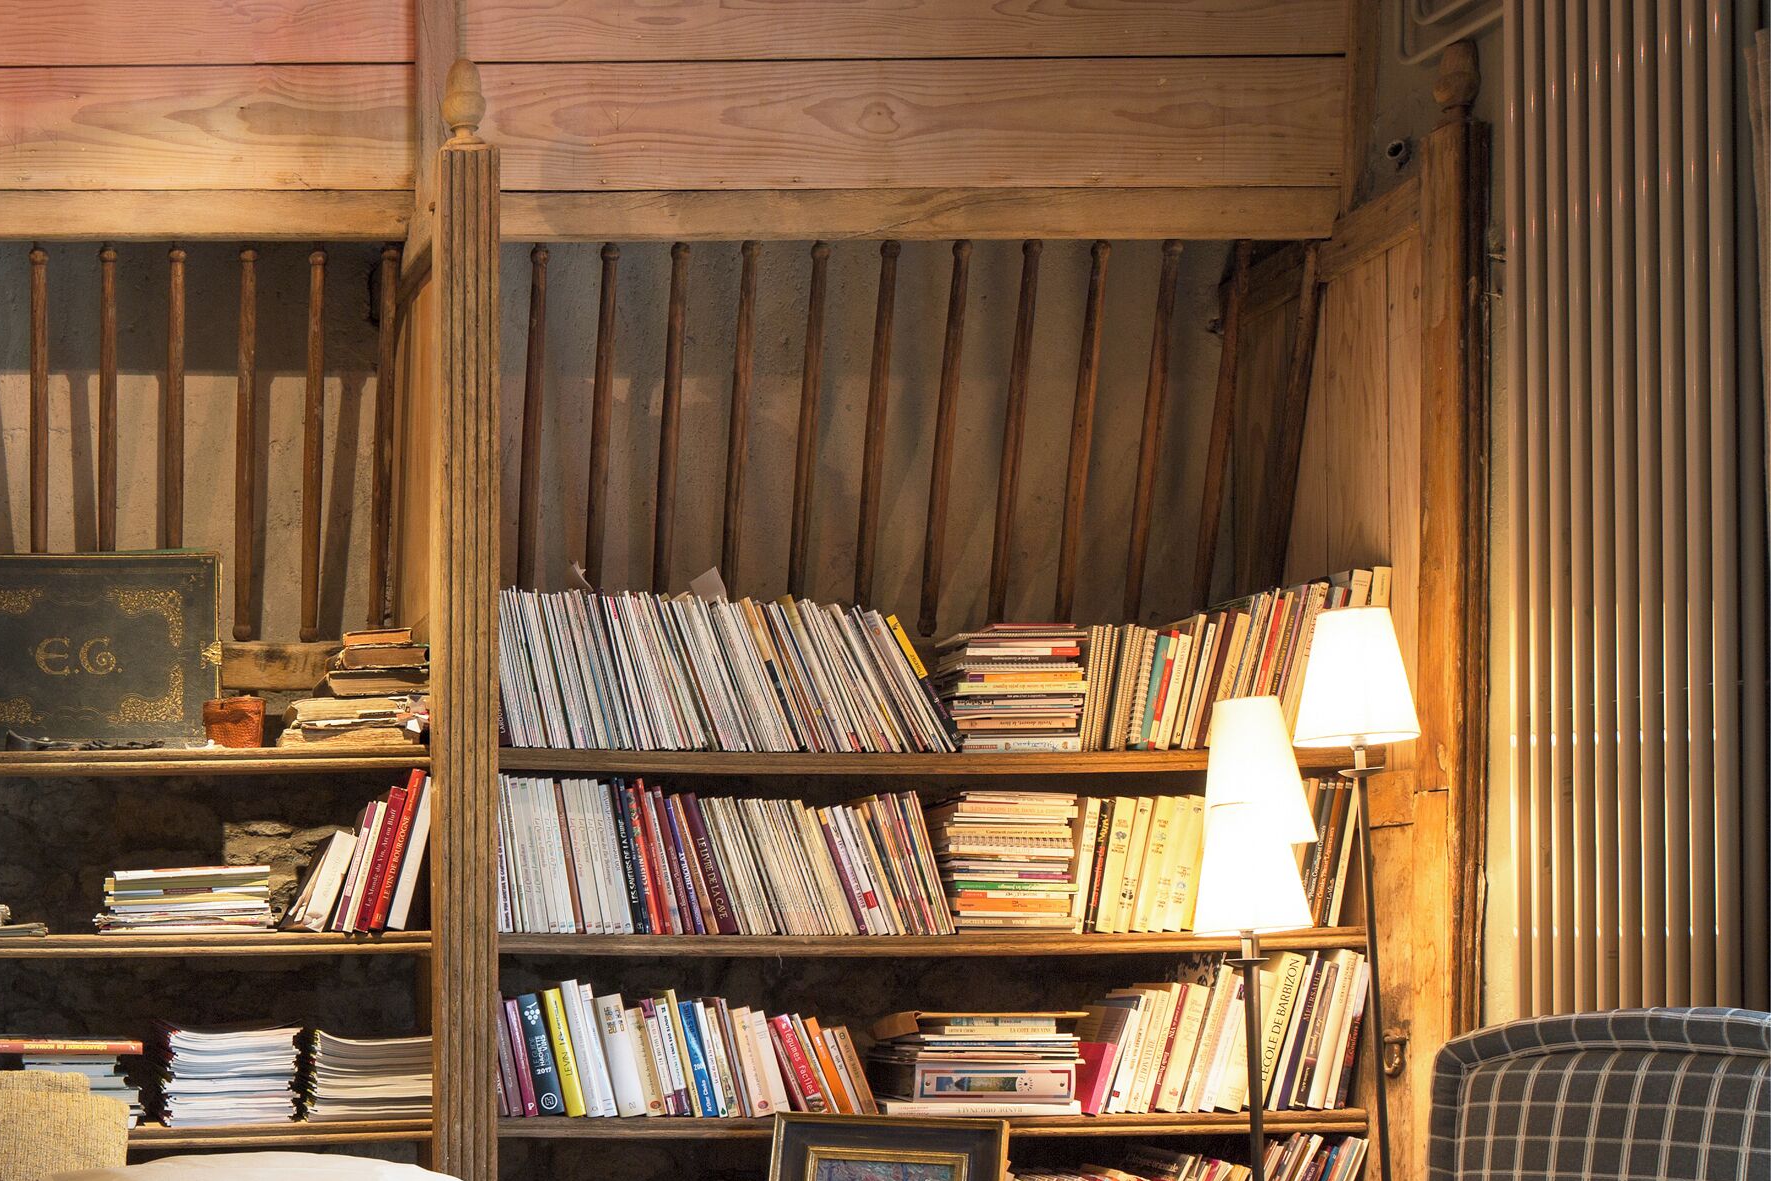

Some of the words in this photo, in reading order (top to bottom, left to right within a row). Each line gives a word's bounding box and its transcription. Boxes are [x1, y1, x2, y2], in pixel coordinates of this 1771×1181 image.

[35, 636, 124, 676] E.G.
[907, 652, 925, 677] Provence
[385, 807, 398, 826] Bluff
[382, 825, 393, 836] ou
[616, 817, 627, 838] CHINE
[379, 835, 390, 848] Art
[391, 814, 411, 863] BOURGOGNE
[620, 837, 629, 849] LA
[695, 836, 707, 849] LE
[622, 848, 631, 860] DE
[698, 847, 714, 872] LIVRE
[372, 861, 383, 873] du
[388, 862, 398, 874] DE
[624, 860, 637, 889] SAVEURS
[677, 850, 693, 890] CHOCOLAT
[366, 872, 380, 896] Monde
[384, 873, 395, 888] VIN
[706, 871, 718, 885] DE
[381, 886, 392, 899] LE
[629, 889, 639, 904] LES
[709, 884, 721, 897] LA
[363, 896, 374, 907] Le
[713, 896, 728, 920] CAVE
[1275, 957, 1300, 1016] BARBIZON
[1302, 968, 1322, 1022] MEURSAULT
[682, 1004, 692, 1020] VINS
[685, 1019, 695, 1033] DES
[1167, 1025, 1176, 1039] VIN
[1271, 1017, 1284, 1035] DE
[527, 1036, 538, 1058] GUIDE
[533, 1034, 546, 1066] HACHETTE
[538, 1033, 548, 1051] VINS
[532, 1057, 540, 1068] LE
[559, 1050, 571, 1066] VIN
[782, 1028, 803, 1062] légumes
[797, 1063, 817, 1095] faciles
[535, 1066, 552, 1075] 2017
[563, 1064, 573, 1076] LE
[703, 1095, 712, 1112] Arthur
